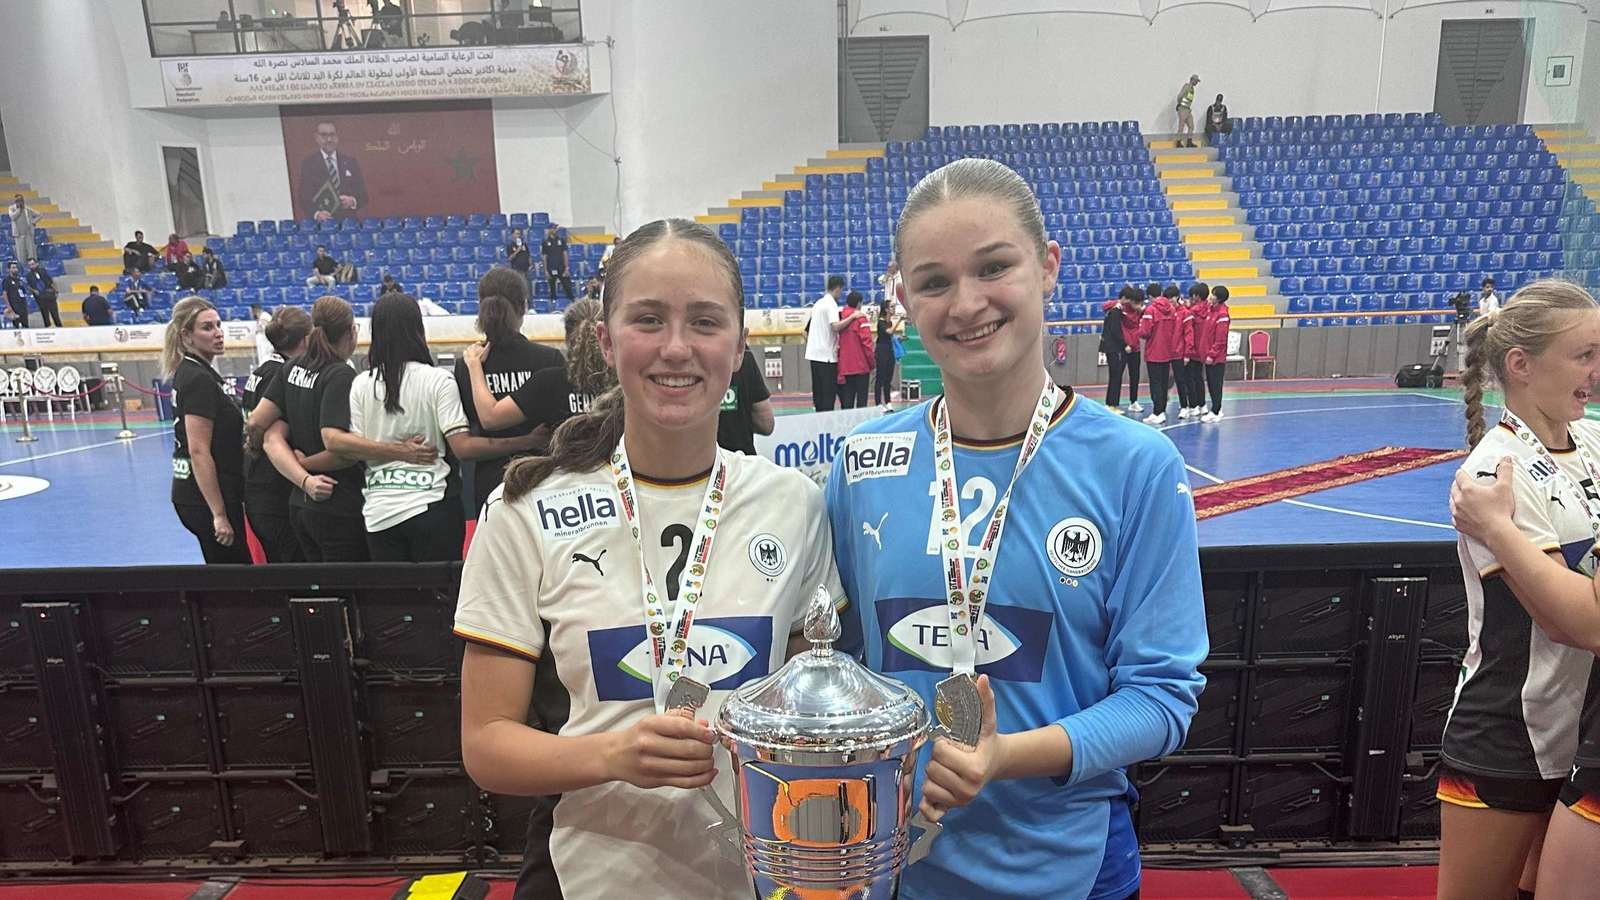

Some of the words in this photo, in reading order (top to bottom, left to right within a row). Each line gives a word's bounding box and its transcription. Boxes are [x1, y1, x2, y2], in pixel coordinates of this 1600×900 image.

[485, 371, 531, 393] ERMANY
[569, 393, 594, 413] GER
[775, 432, 846, 467] molt
[845, 441, 910, 474] hella
[370, 468, 432, 486] ALSCO
[536, 493, 617, 530] hella
[912, 624, 990, 651] TEA
